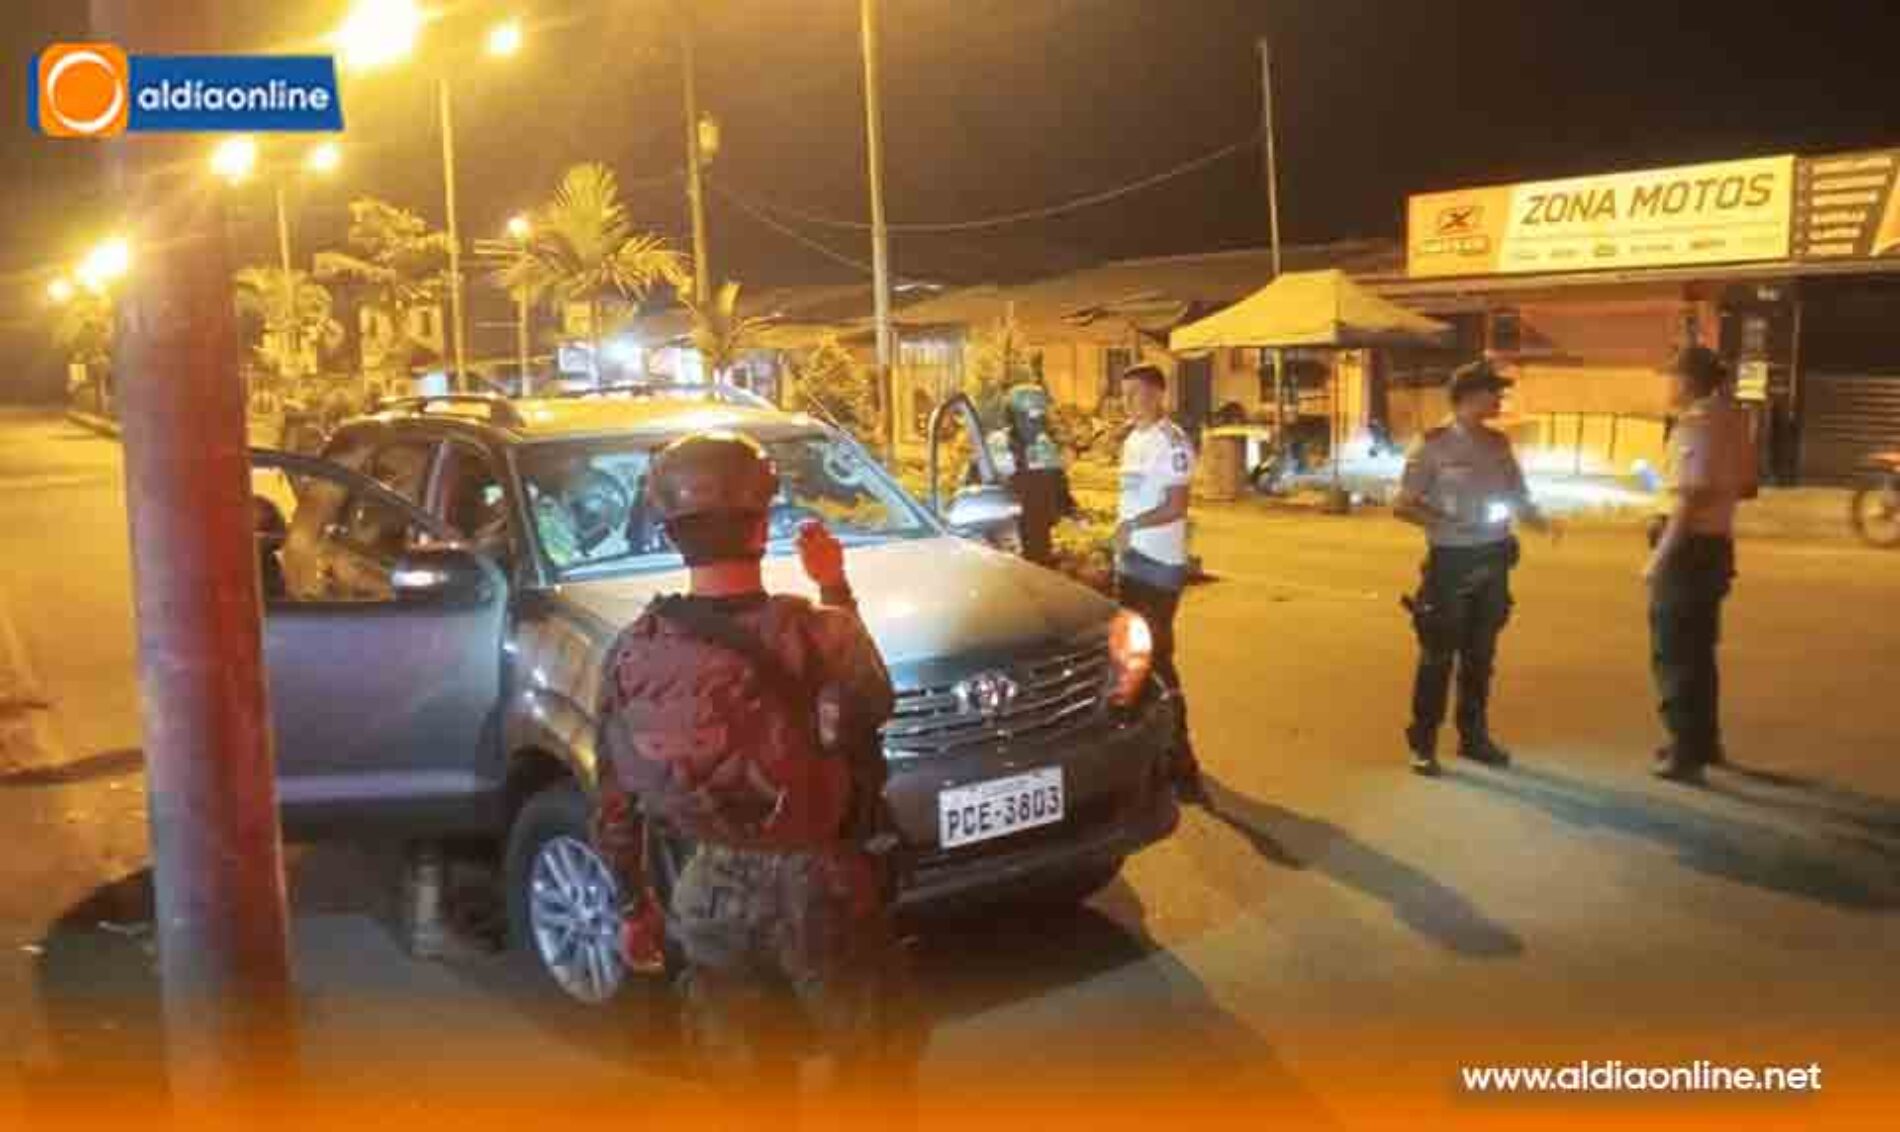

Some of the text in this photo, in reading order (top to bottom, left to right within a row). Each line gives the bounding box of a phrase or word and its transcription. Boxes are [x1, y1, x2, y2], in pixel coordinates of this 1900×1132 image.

[1520, 173, 1775, 226] ZONA MOTOS
[946, 785, 1060, 839] PCE-3803
